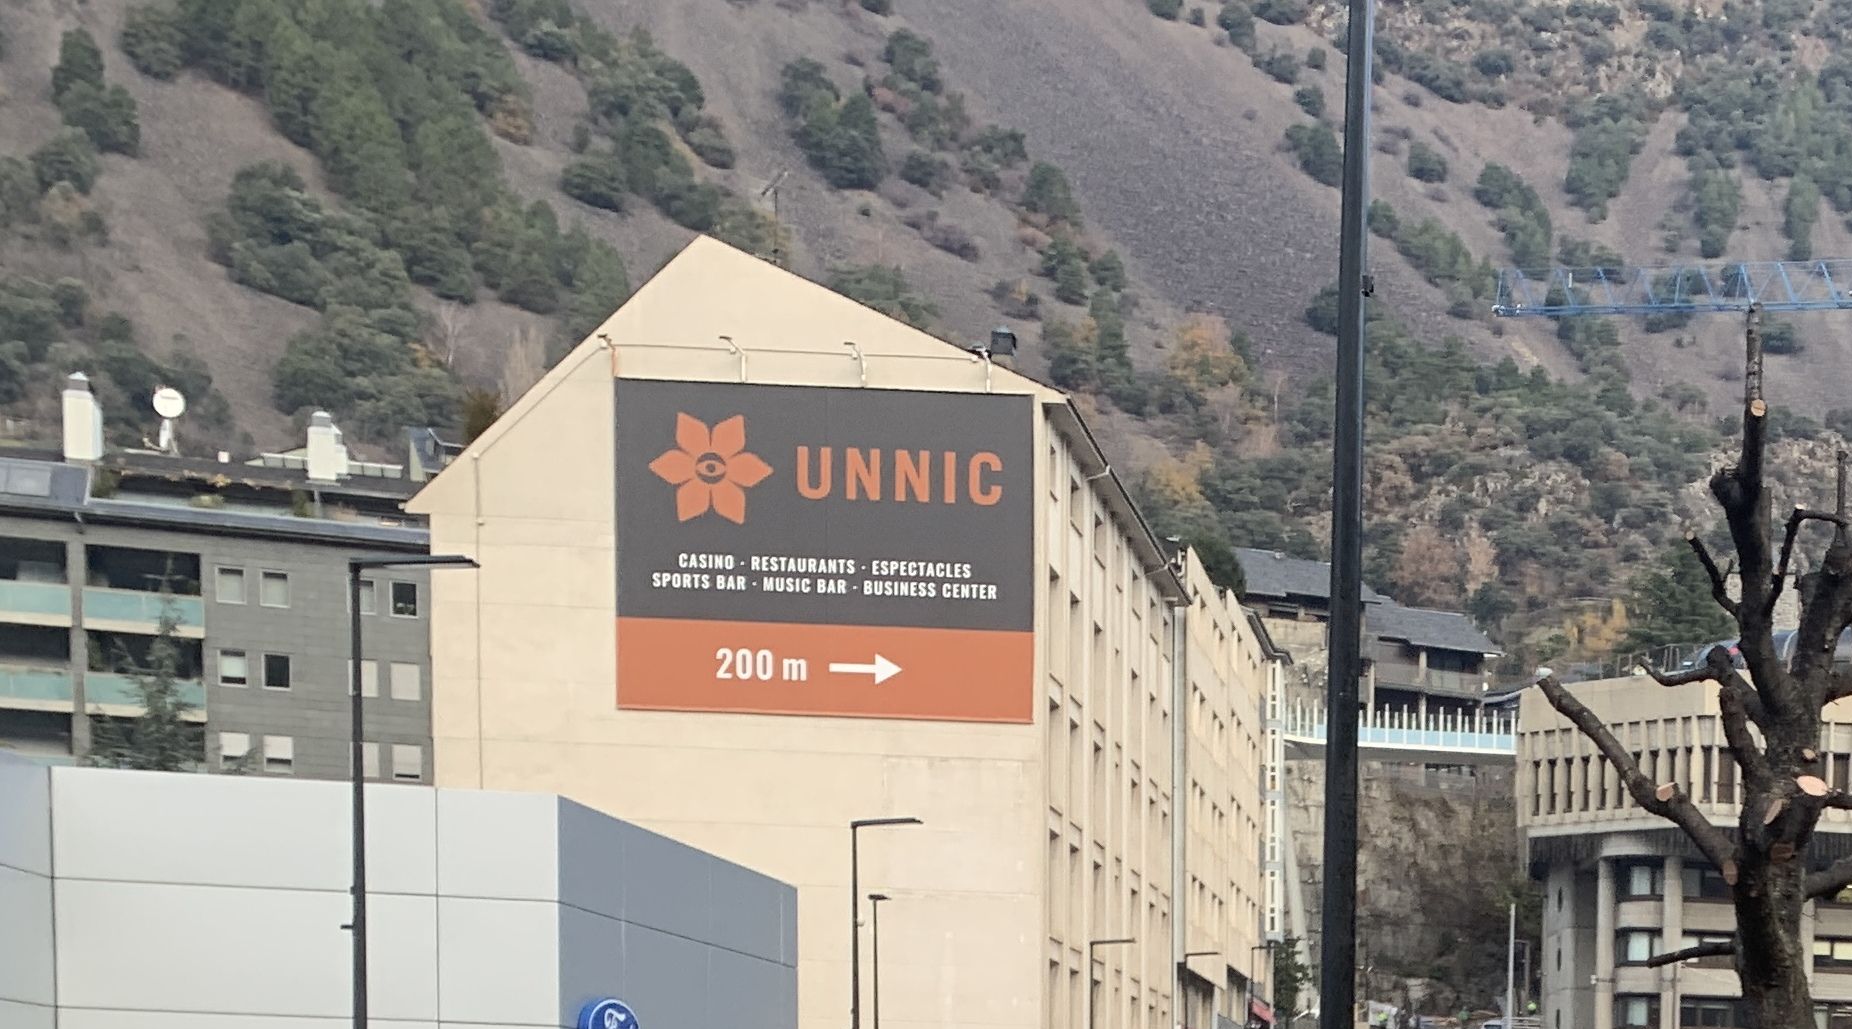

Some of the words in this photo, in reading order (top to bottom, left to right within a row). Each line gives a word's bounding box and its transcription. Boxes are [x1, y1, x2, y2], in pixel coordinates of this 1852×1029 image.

[797, 446, 1003, 506] UNNIC
[678, 553, 735, 570] CASINO
[751, 556, 856, 575] RESTAURANTS
[872, 560, 972, 579] ESPECTACLES
[652, 572, 711, 589] SPORTS
[716, 575, 747, 591] BAR
[763, 577, 811, 594] MUSIC
[817, 580, 848, 595] BAR
[863, 581, 937, 598] BUSINESS
[942, 583, 998, 600] CENTER
[715, 648, 774, 681] 200
[783, 658, 808, 681] m
